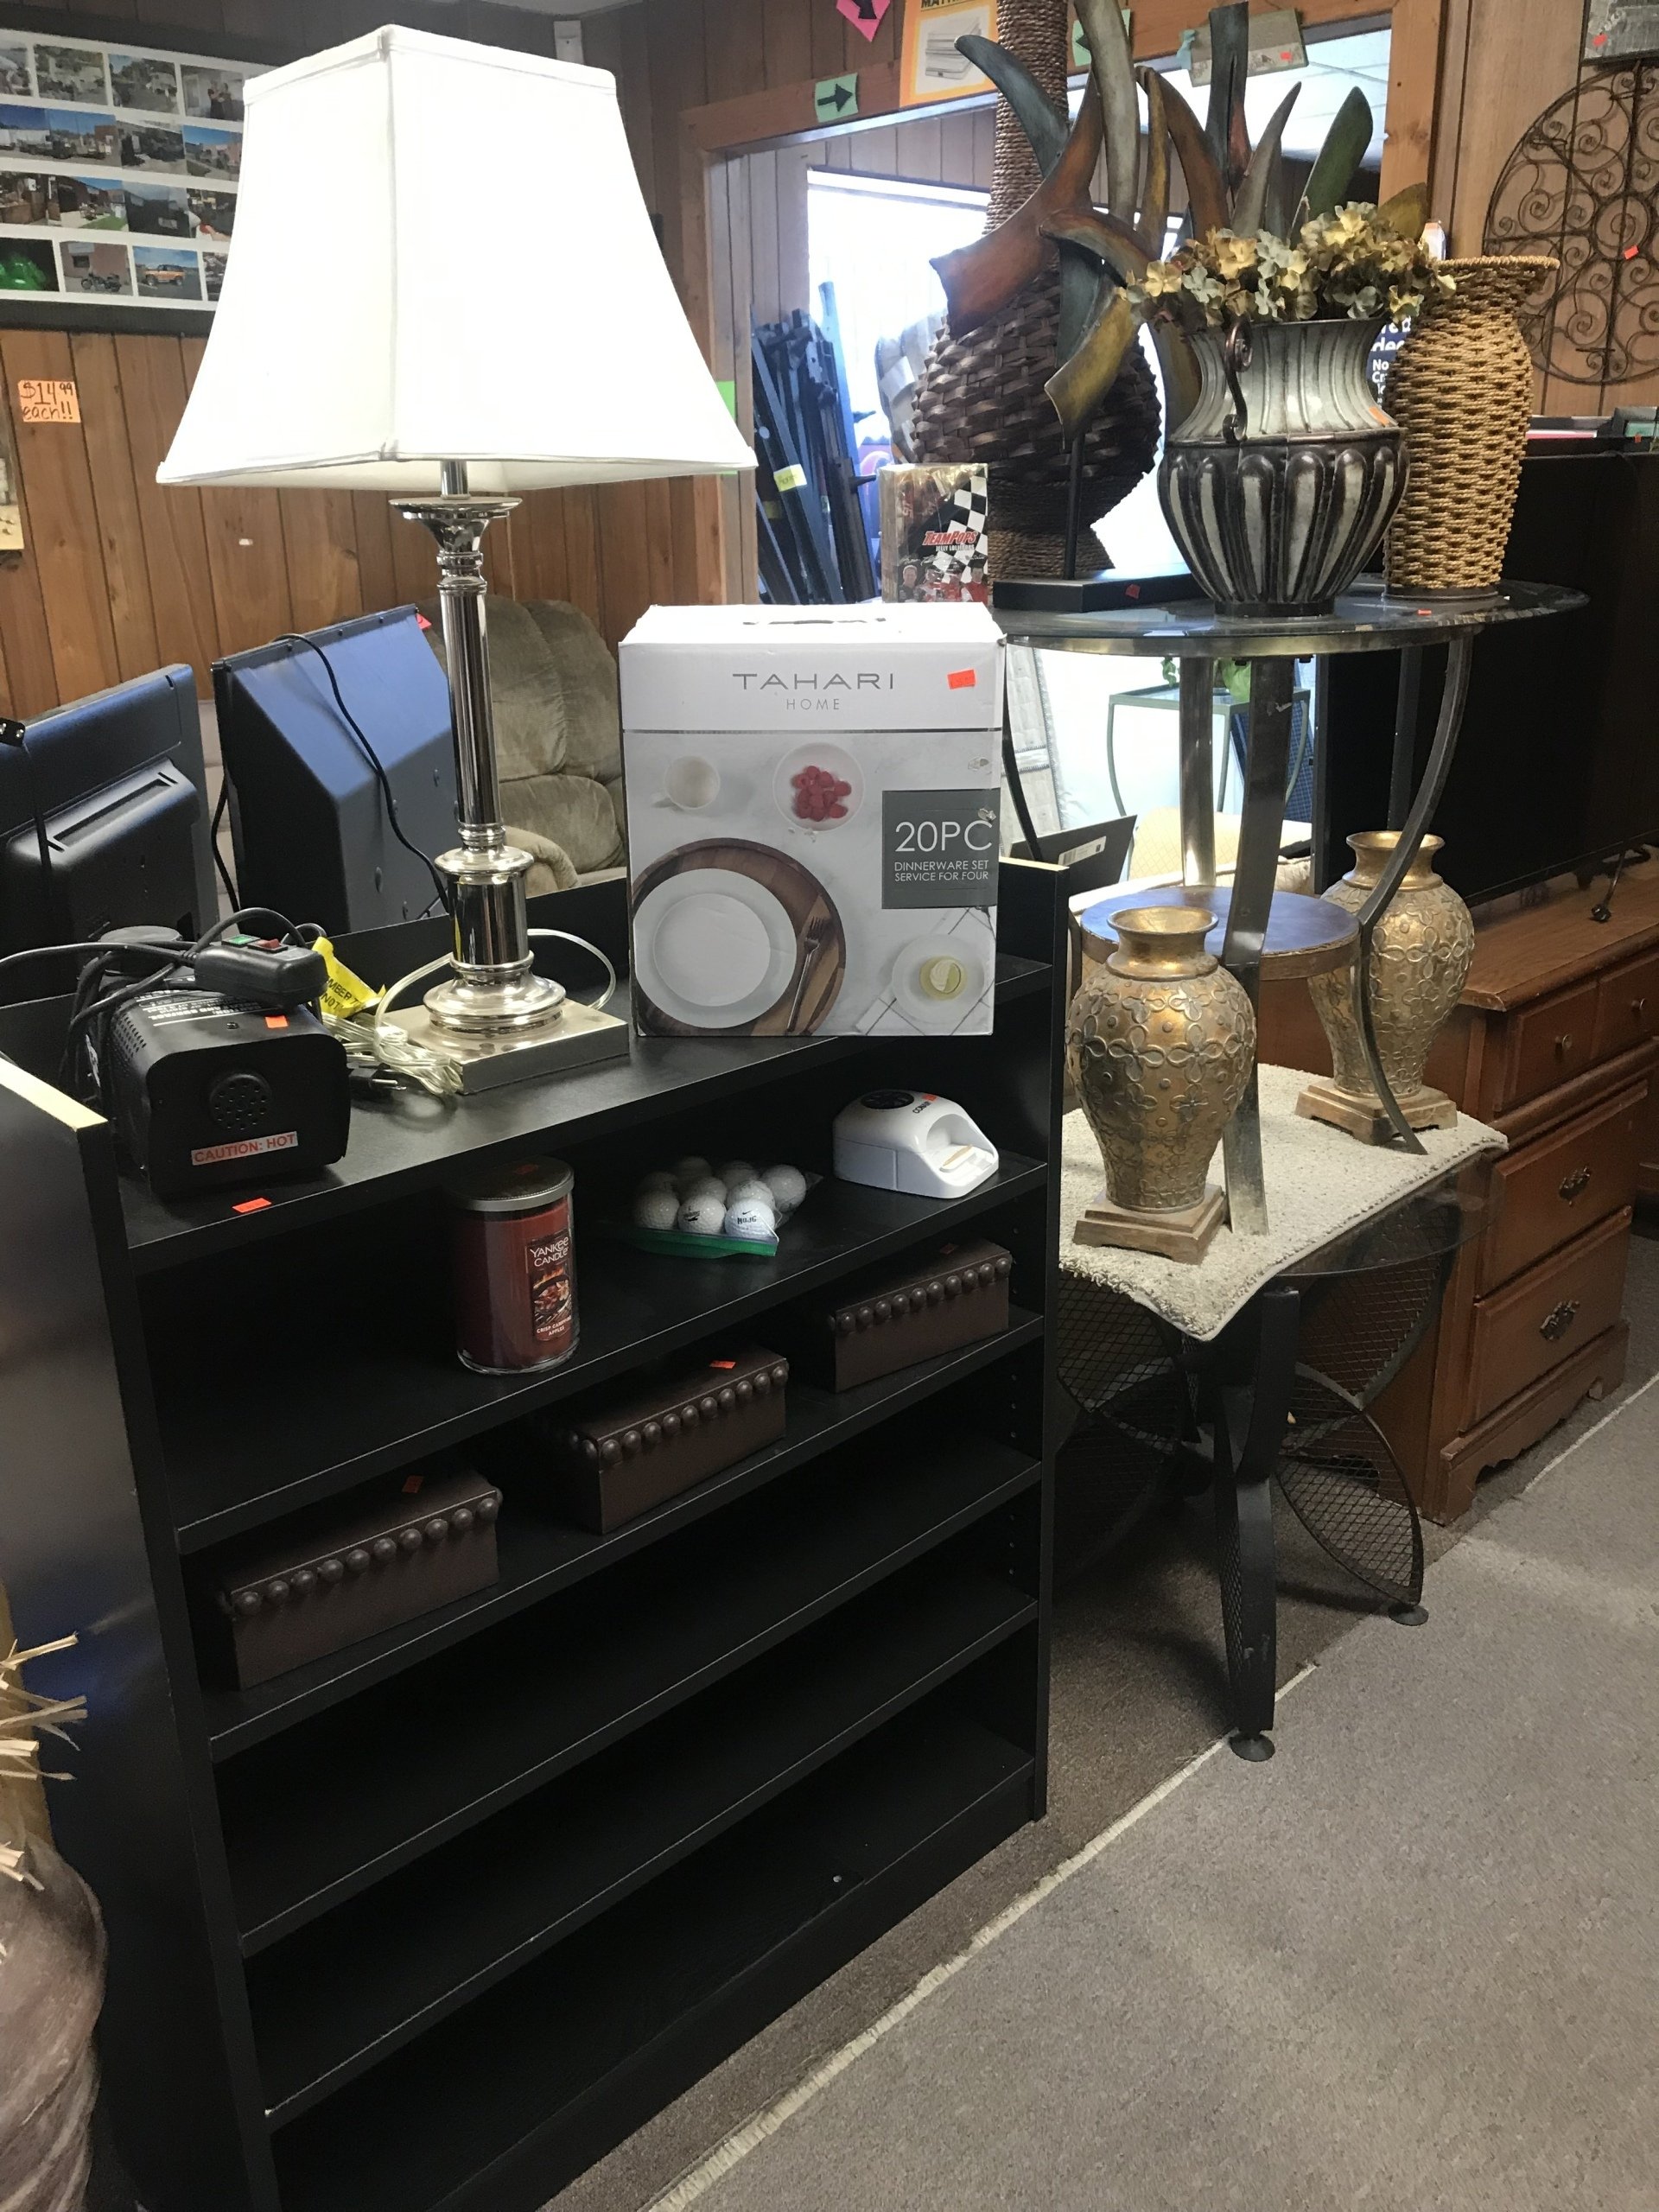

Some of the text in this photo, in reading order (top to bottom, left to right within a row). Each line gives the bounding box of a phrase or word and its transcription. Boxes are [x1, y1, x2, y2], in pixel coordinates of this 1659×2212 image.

[732, 673, 894, 690] TAHARI
[786, 698, 840, 710] HOME
[894, 820, 993, 852] 20PC
[894, 860, 989, 872] DINNERWARE SET
[894, 871, 989, 882] SERVICE FOR FOUR
[194, 1133, 296, 1163] CAUTION: HOT
[548, 1325, 565, 1336] APPLES
